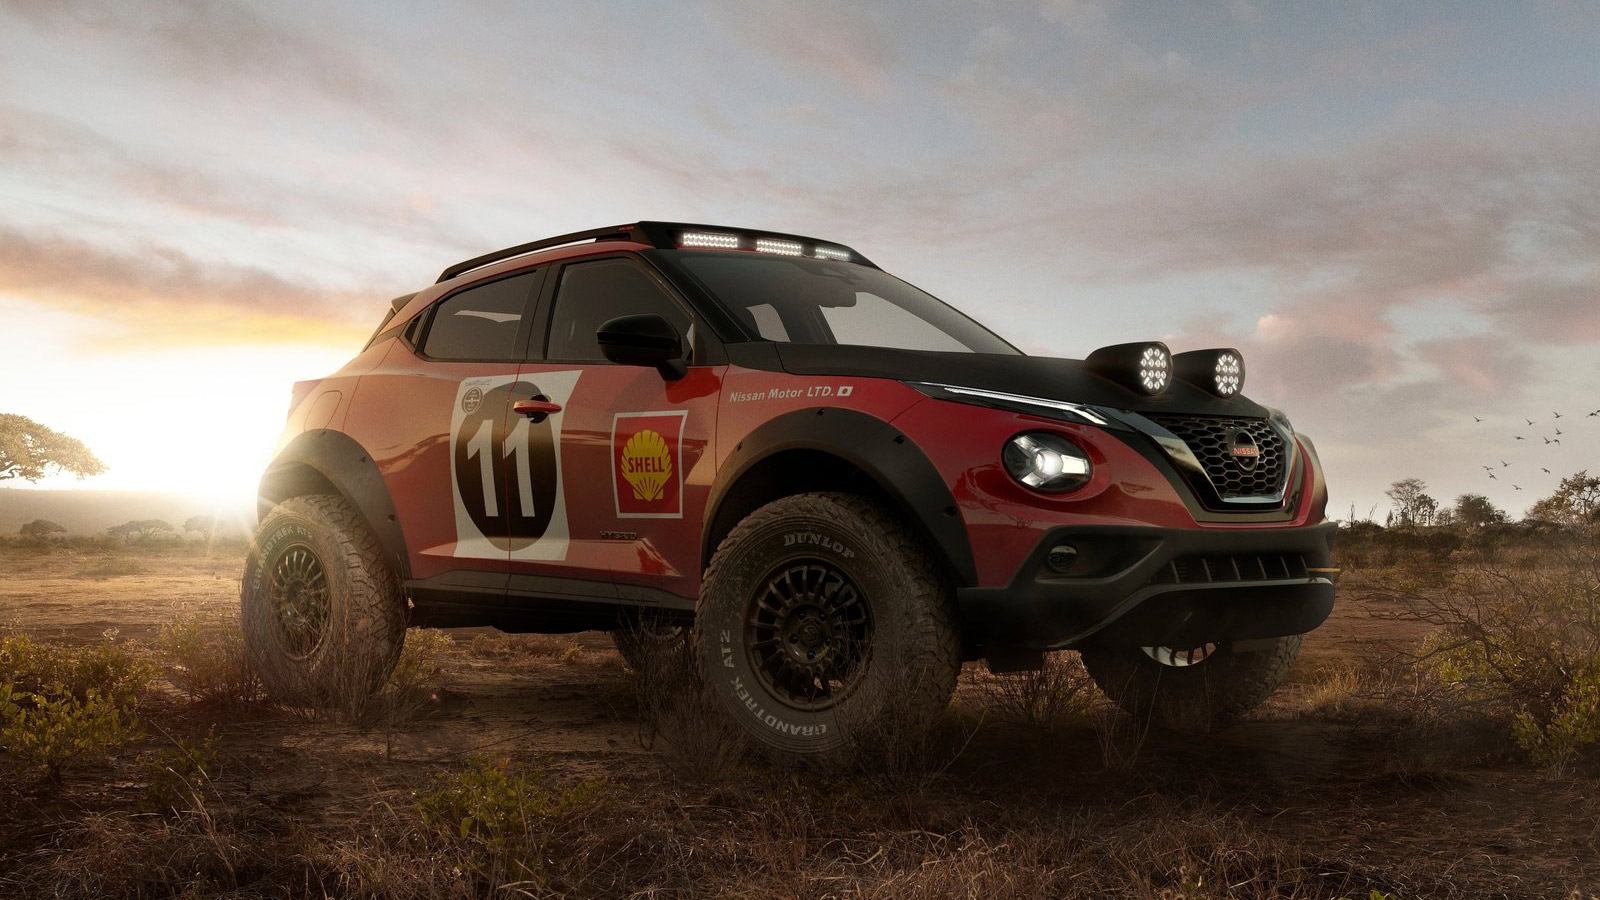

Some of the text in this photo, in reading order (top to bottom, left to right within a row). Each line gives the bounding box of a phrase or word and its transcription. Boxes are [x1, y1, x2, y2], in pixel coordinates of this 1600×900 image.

[729, 386, 835, 403] Nissan Motor LTD.
[466, 418, 536, 517] 11
[628, 456, 666, 474] SHELL
[783, 531, 855, 559] DUNLOP
[719, 629, 828, 737] GRANDTREK AT2
